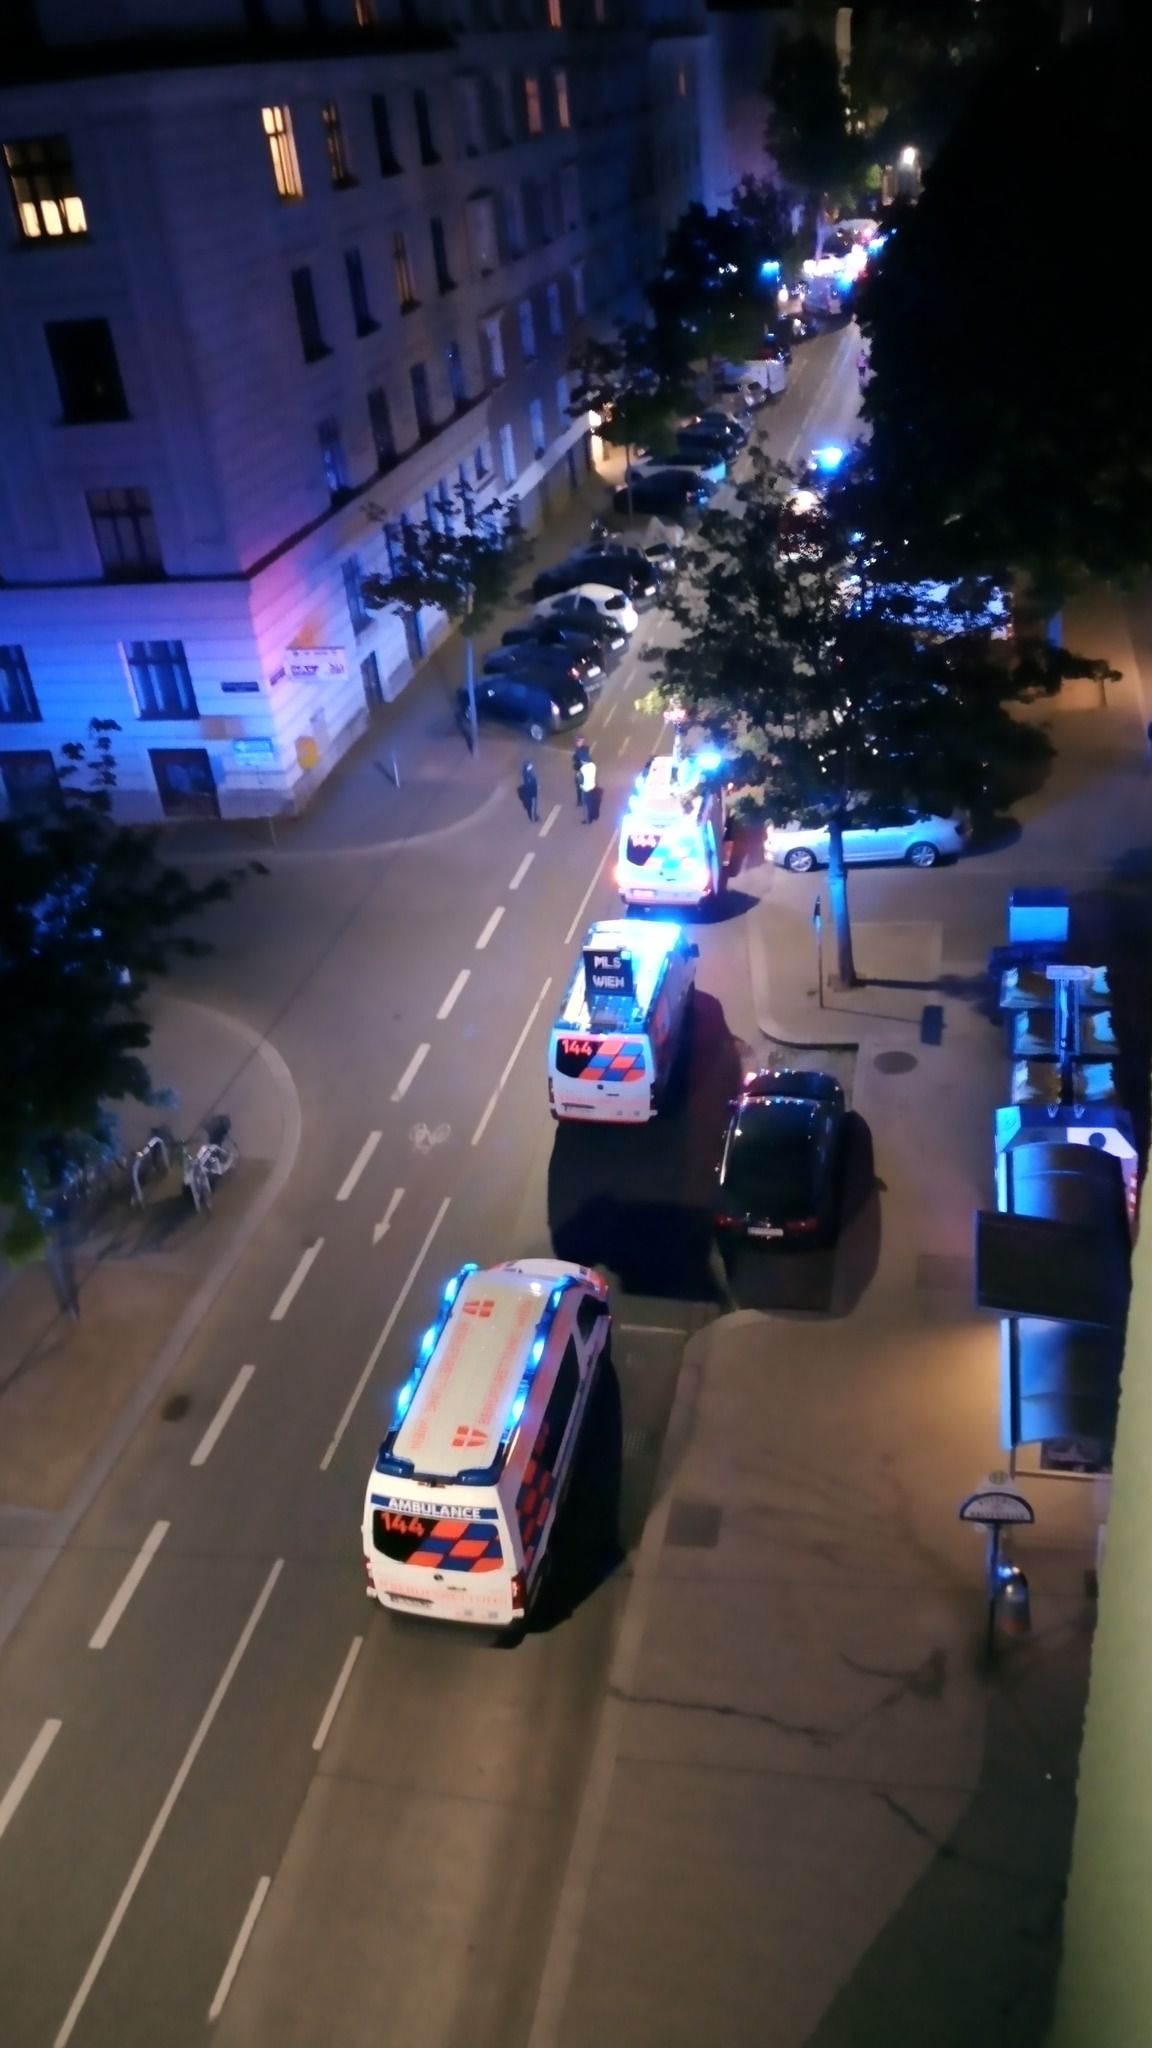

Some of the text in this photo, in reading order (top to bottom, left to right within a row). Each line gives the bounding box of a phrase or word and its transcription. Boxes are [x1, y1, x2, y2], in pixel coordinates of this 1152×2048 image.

[594, 955, 622, 970] MLS
[592, 975, 625, 989] WIEN
[562, 1039, 592, 1057] 144
[388, 1498, 481, 1519] AMBULANCE
[381, 1512, 425, 1537] 144
